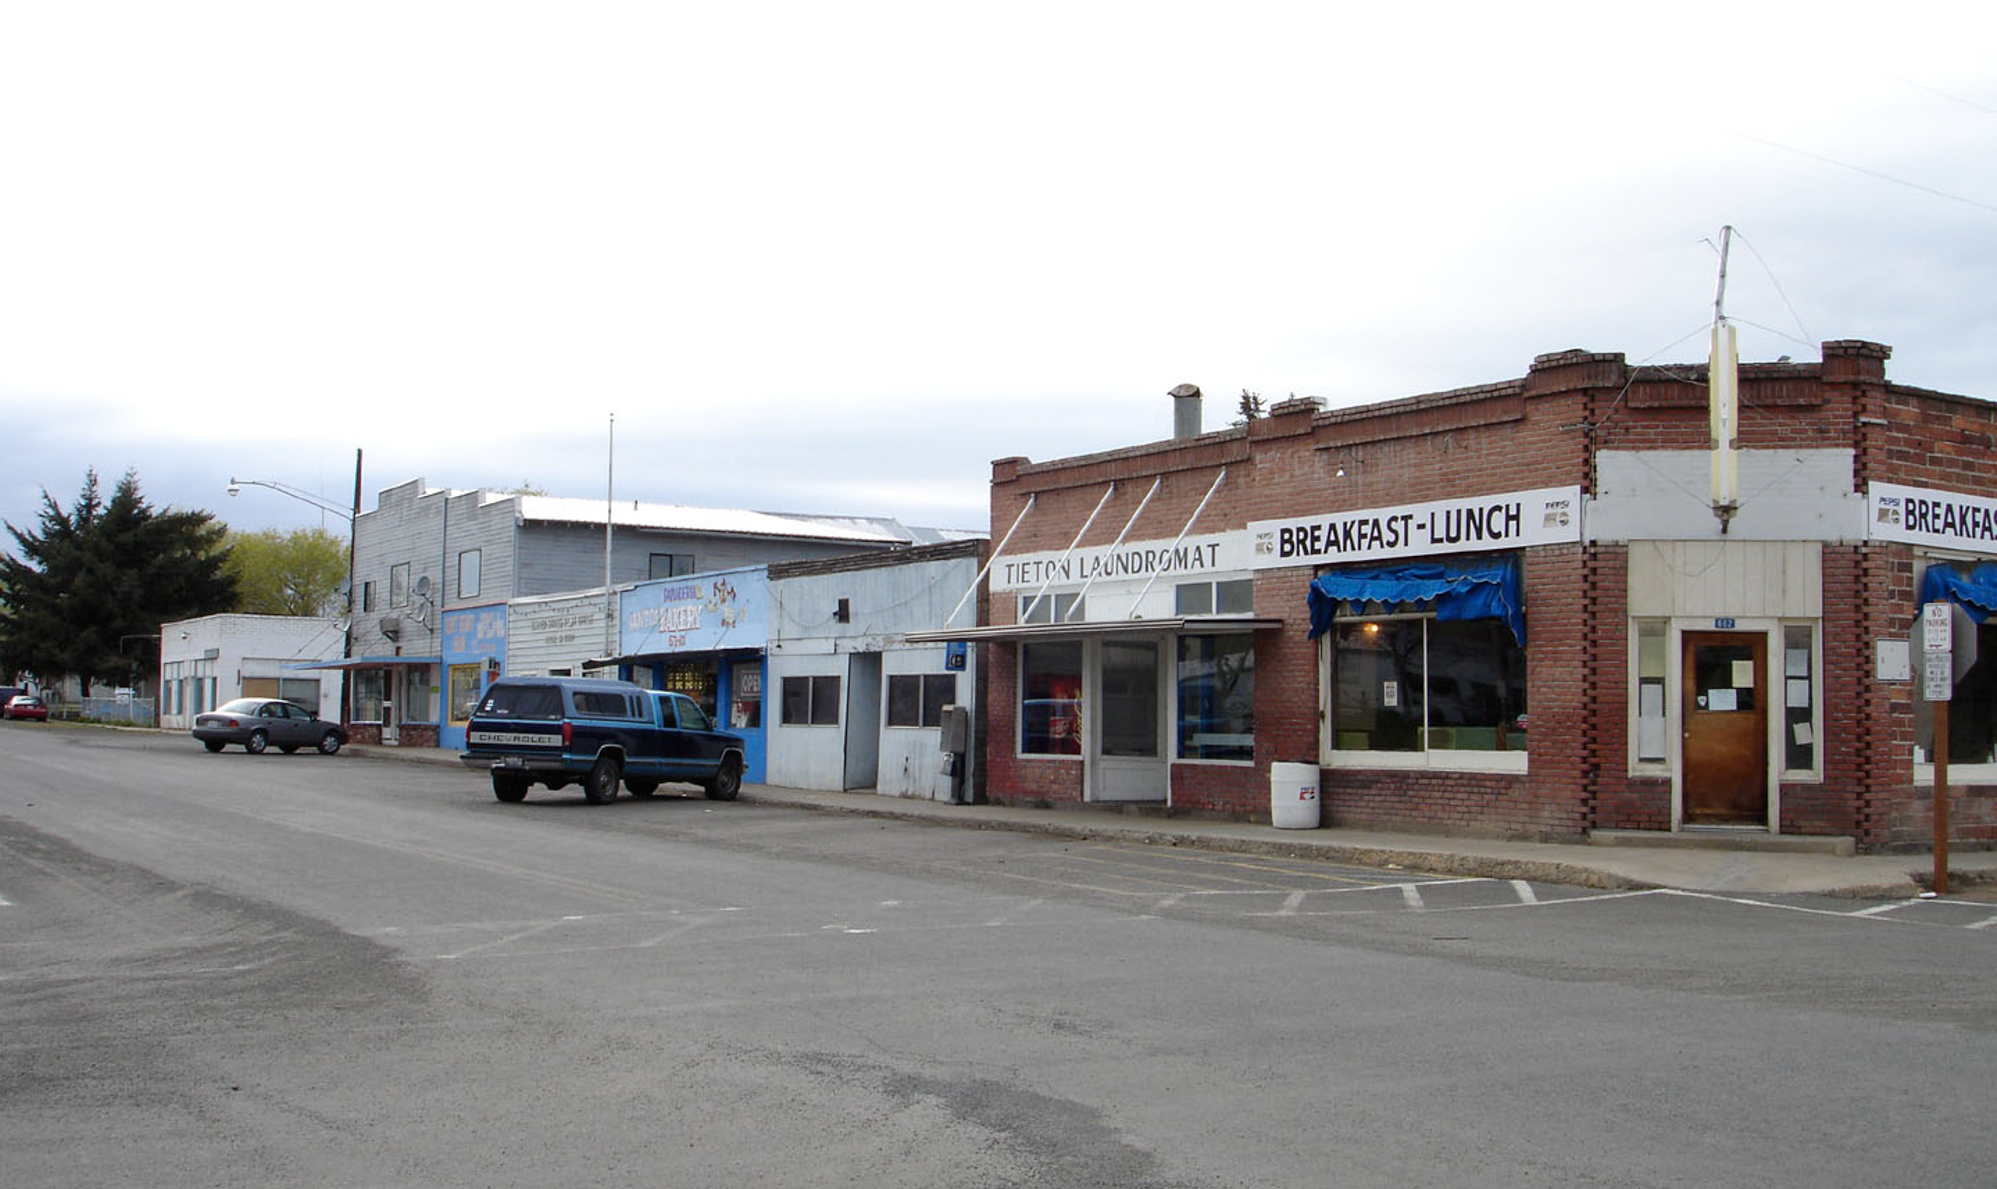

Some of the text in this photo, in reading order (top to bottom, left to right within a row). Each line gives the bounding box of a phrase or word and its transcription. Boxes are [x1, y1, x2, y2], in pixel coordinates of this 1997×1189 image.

[1880, 497, 1900, 507] PEPSI
[1904, 497, 1997, 541] BREAKFA
[1279, 502, 1522, 558] BREAKFAST-LUNCH
[1005, 543, 1220, 585] TIETON LAUNDROMAT
[479, 734, 552, 743] CHEVROLET
